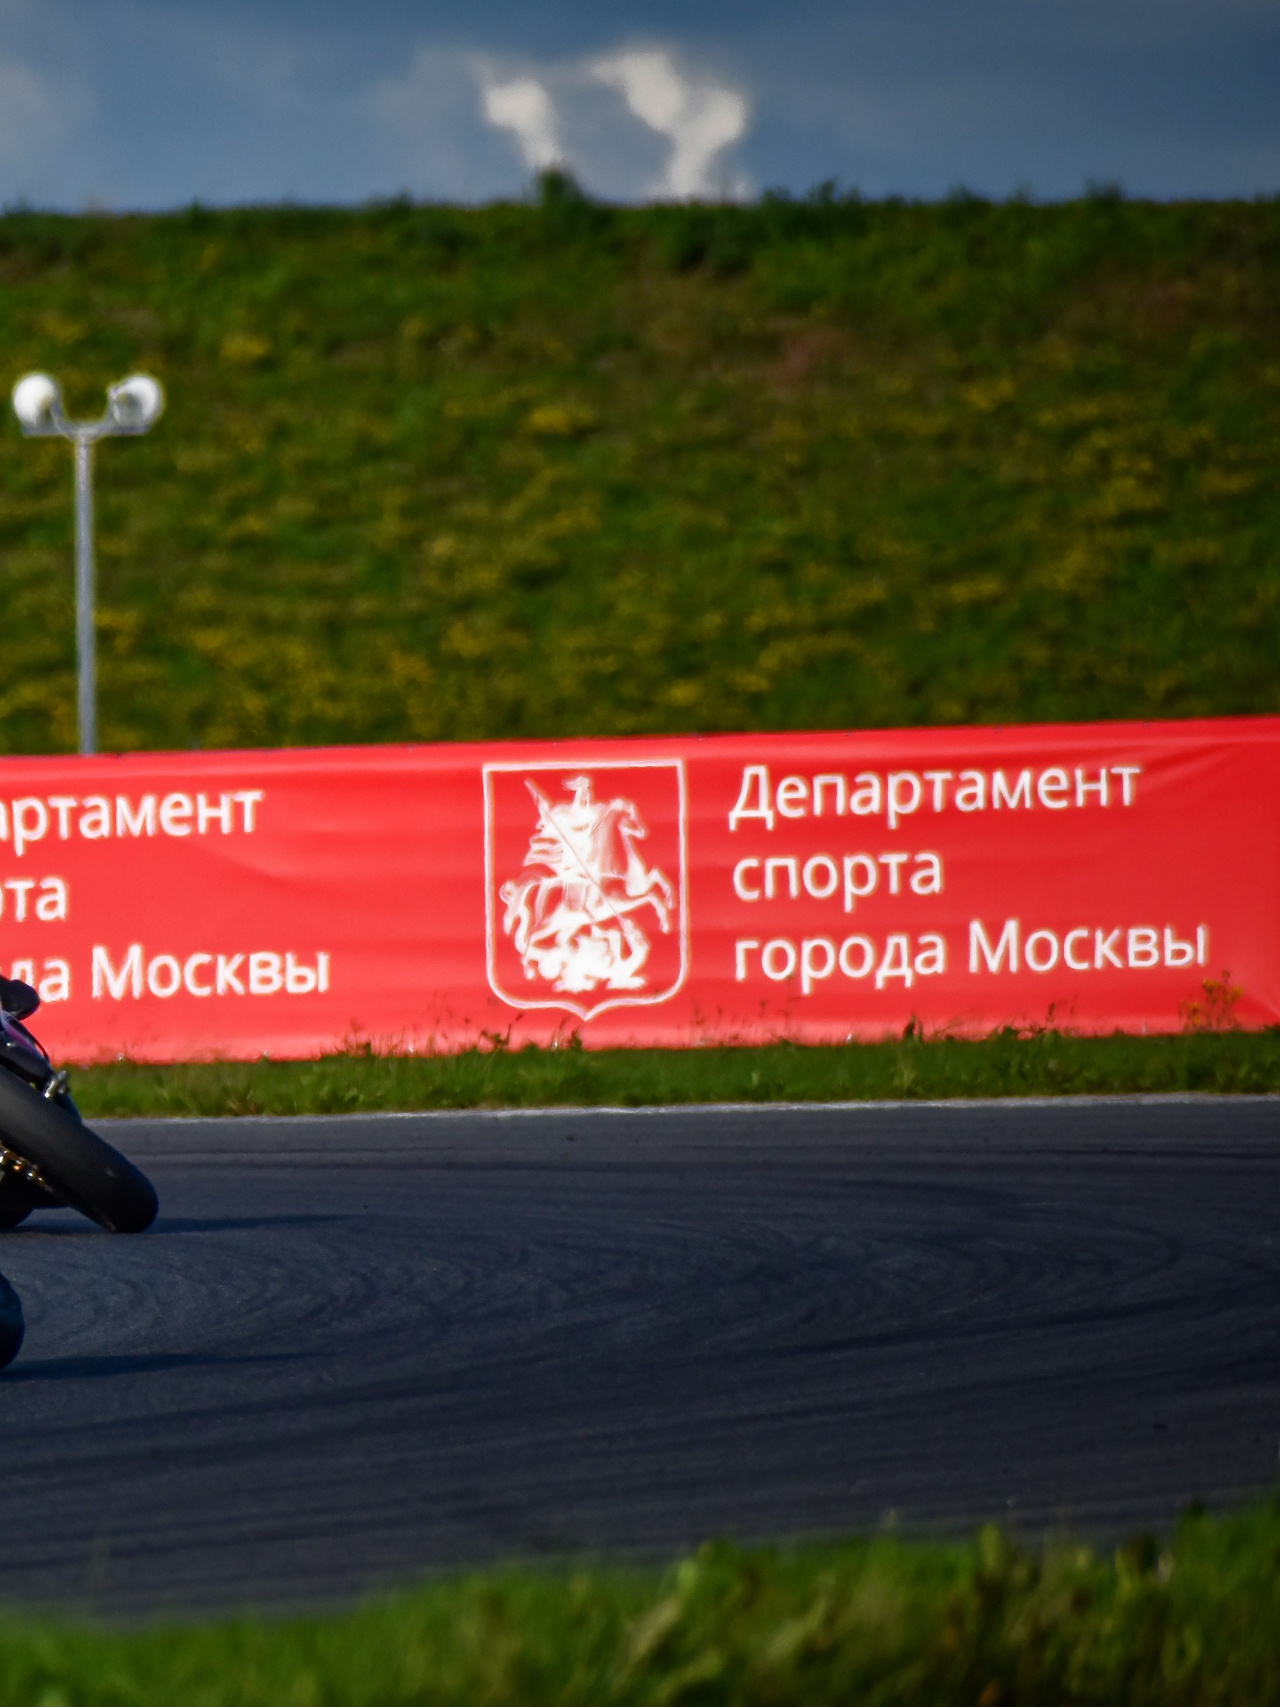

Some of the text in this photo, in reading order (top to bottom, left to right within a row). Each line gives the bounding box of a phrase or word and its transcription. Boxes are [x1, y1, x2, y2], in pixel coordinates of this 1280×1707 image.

[727, 764, 1141, 830] Департамент
[732, 851, 943, 913] спорта
[90, 942, 331, 1002] Москвы
[734, 918, 1207, 995] города Москвы
